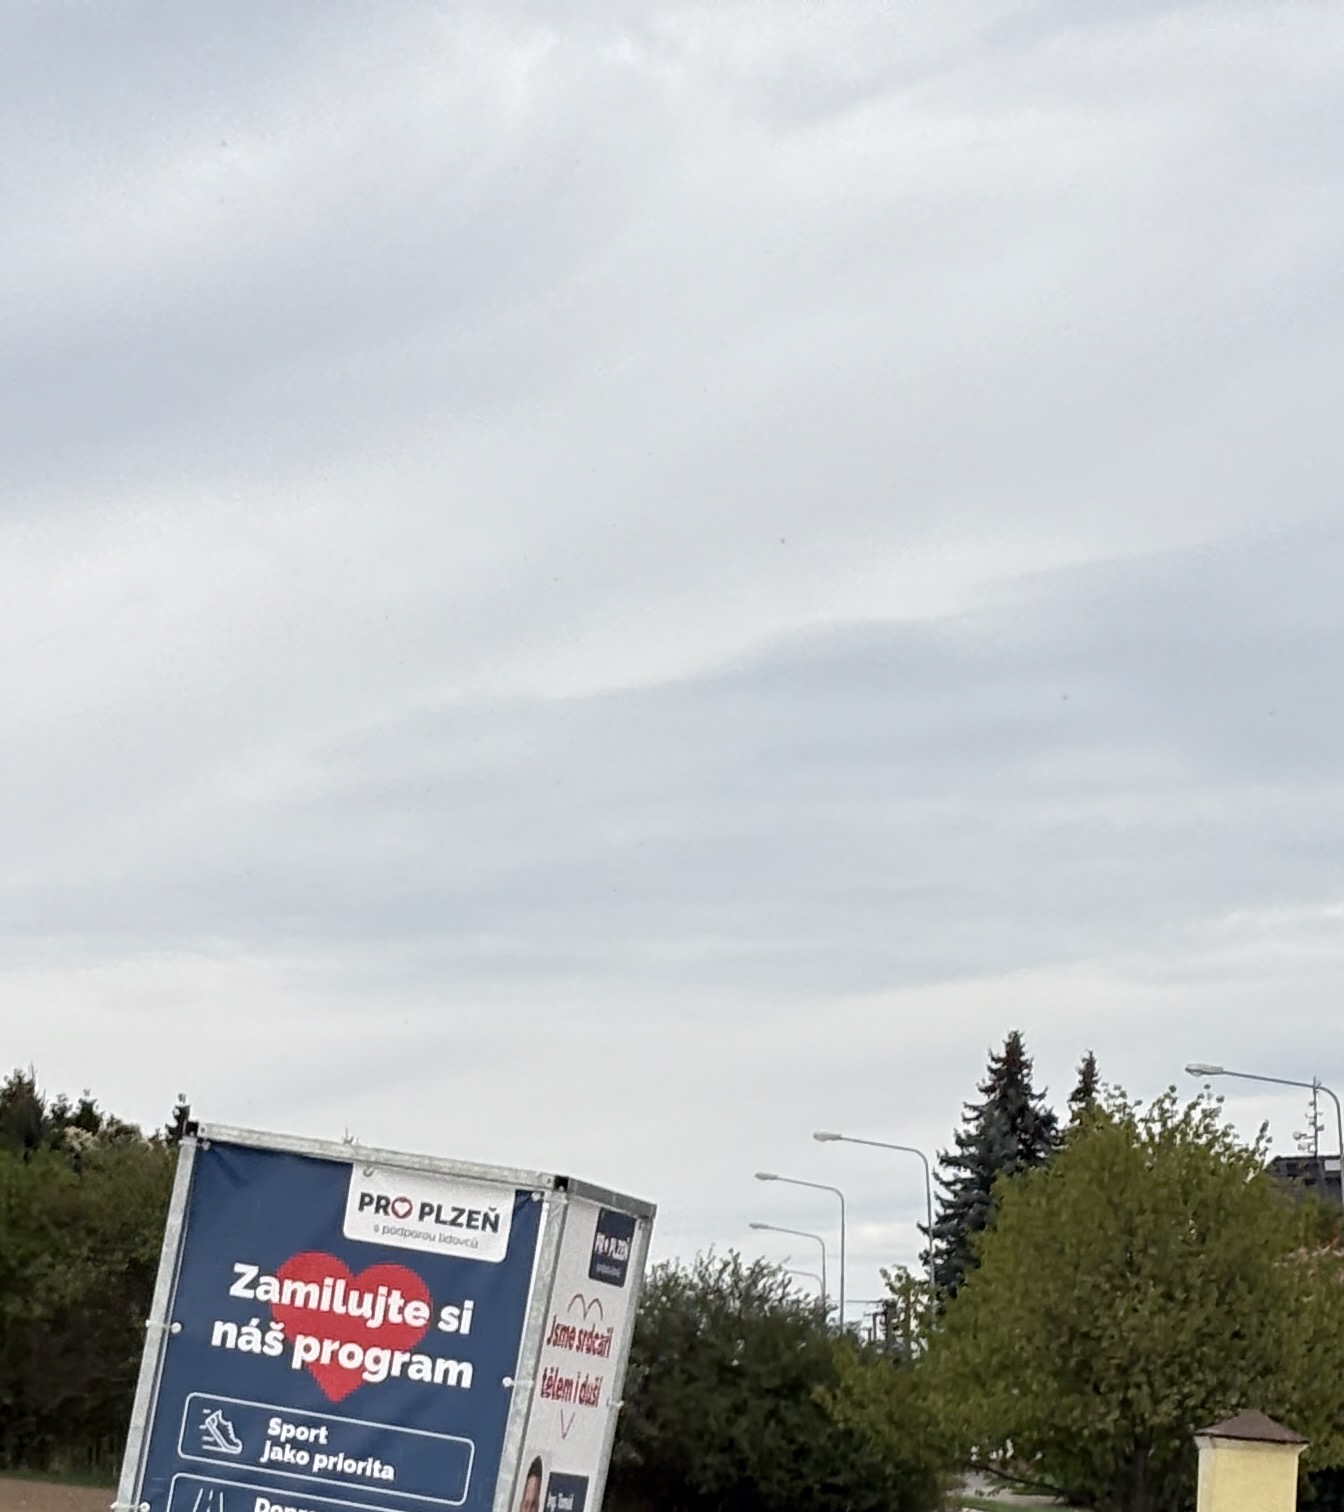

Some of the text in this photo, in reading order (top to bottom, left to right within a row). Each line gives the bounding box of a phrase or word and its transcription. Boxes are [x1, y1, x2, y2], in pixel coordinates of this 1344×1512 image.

[358, 1191, 500, 1233] PRO PLZEŇ
[382, 1225, 436, 1242] podporou
[438, 1232, 479, 1249] lidovců
[229, 1262, 475, 1335] Zamilujte si
[546, 1314, 576, 1350] Jsme
[211, 1317, 474, 1389] náš program
[540, 1366, 574, 1404] tělem
[573, 1371, 581, 1404] i
[267, 1417, 328, 1445] Sport
[259, 1440, 395, 1481] jako priorita
